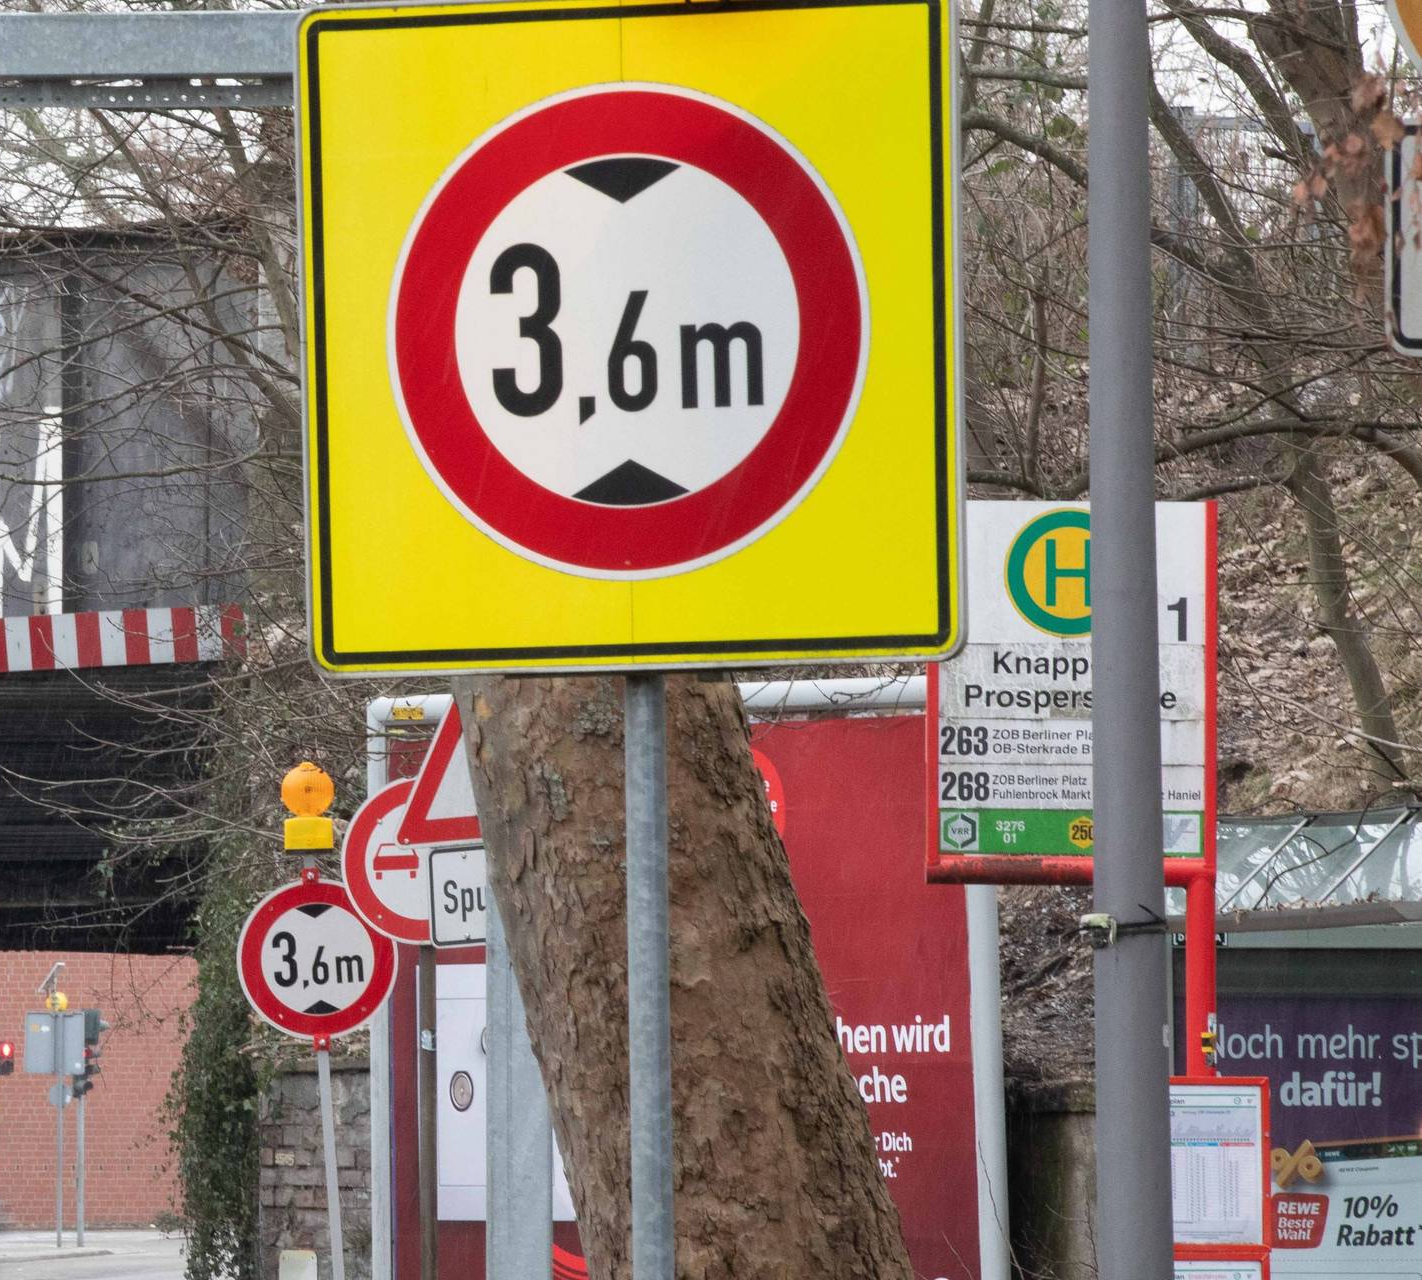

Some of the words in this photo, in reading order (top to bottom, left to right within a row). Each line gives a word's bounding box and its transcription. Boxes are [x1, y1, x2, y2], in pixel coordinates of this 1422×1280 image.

[1167, 597, 1187, 641] 1
[993, 651, 1093, 680] Knapp
[940, 726, 989, 756] 263
[992, 729, 1020, 740] ZOB
[1022, 729, 1072, 740] Berliner
[1076, 729, 1094, 740] Pla
[992, 743, 1078, 754] OB-Sterkrade
[1082, 743, 1093, 754] B
[941, 771, 990, 801] 268
[992, 775, 1016, 785] ZOB
[1017, 775, 1058, 785] Berliner
[1062, 775, 1087, 785] Platz
[992, 789, 1059, 800] Fuhlenbrock
[1061, 789, 1091, 800] Markt
[1168, 790, 1201, 800] Haniel
[995, 821, 1026, 831] 3276
[1002, 833, 1017, 844] 01
[443, 880, 487, 922] Spu
[836, 1016, 887, 1053] hen
[891, 1014, 951, 1053] wird
[1297, 1024, 1381, 1059] mehr
[1392, 1031, 1422, 1069] sp
[854, 1065, 908, 1103] che
[1280, 1071, 1382, 1107] dafür!
[881, 1131, 913, 1151] Dich
[1277, 1202, 1321, 1215] REWE
[1343, 1194, 1399, 1219] 10%
[1277, 1228, 1311, 1240] Wahl
[1278, 1217, 1315, 1229] Beste
